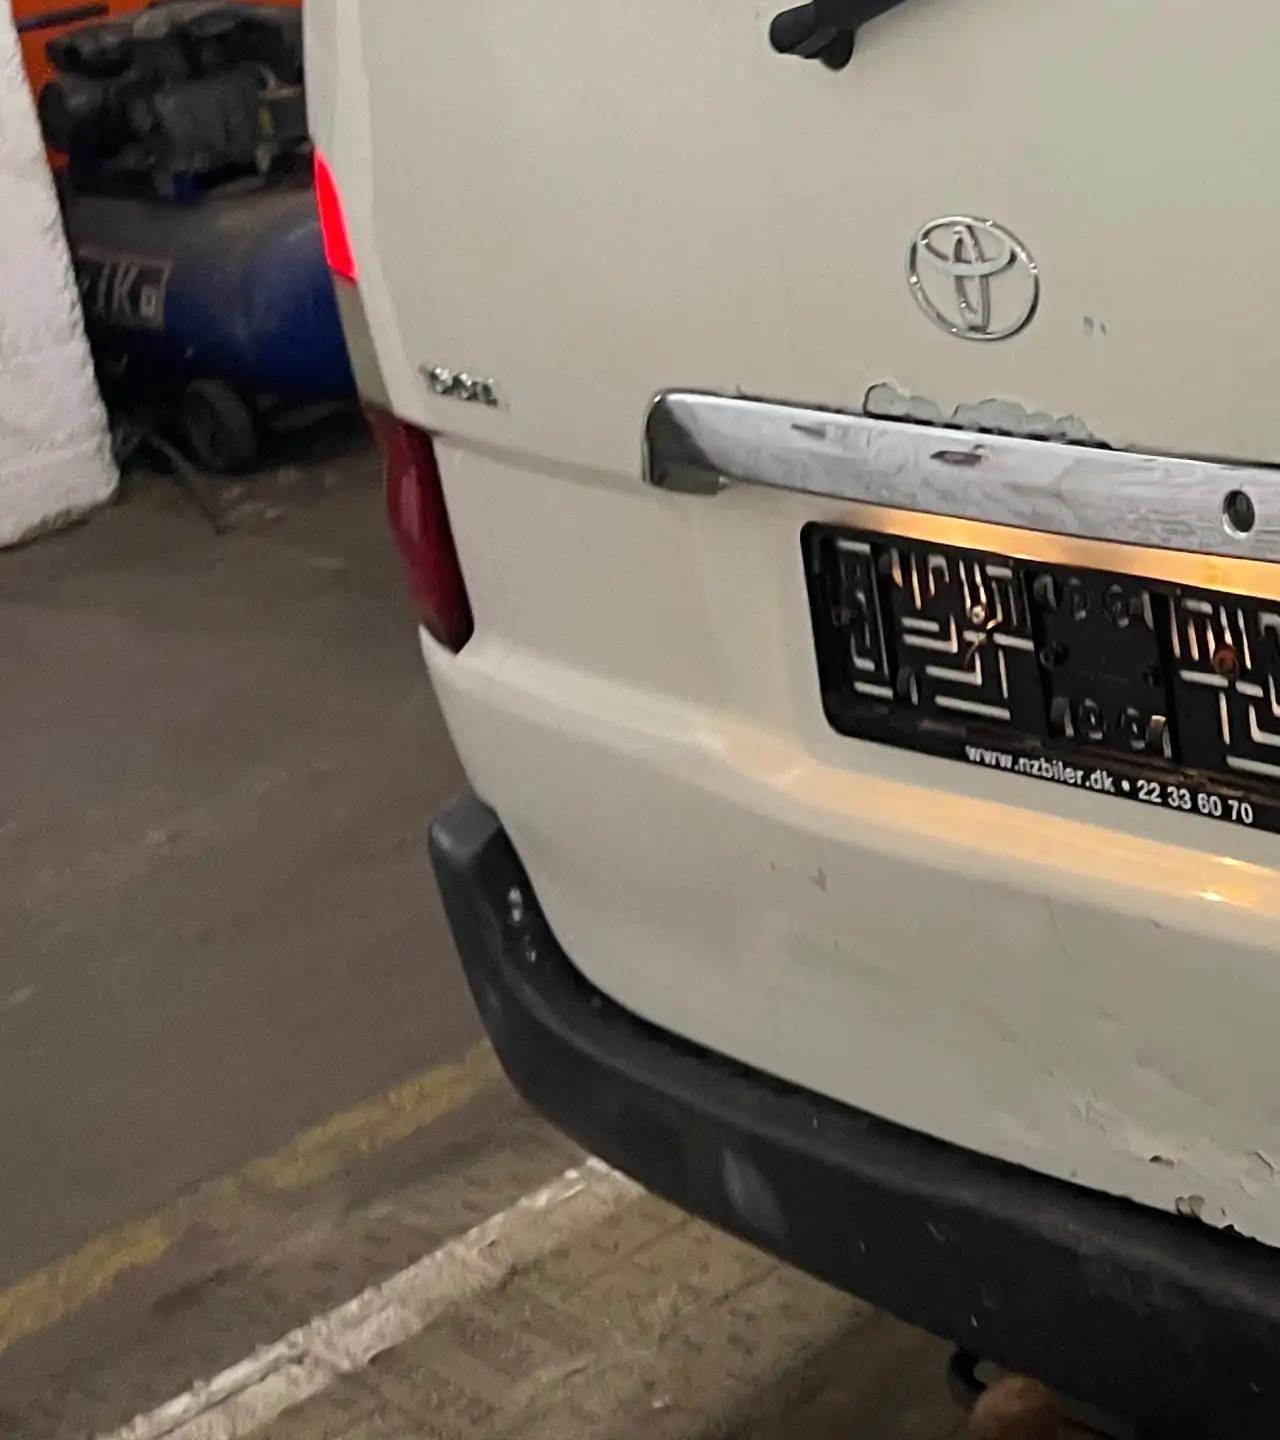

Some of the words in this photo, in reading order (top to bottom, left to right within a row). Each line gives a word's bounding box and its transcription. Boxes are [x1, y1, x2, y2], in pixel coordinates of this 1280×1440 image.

[965, 745, 1115, 793] www.nzbiler.dk
[1136, 779, 1162, 803] 22
[1167, 786, 1192, 809] 33
[1197, 793, 1222, 816] 60
[1228, 800, 1254, 824] 70
